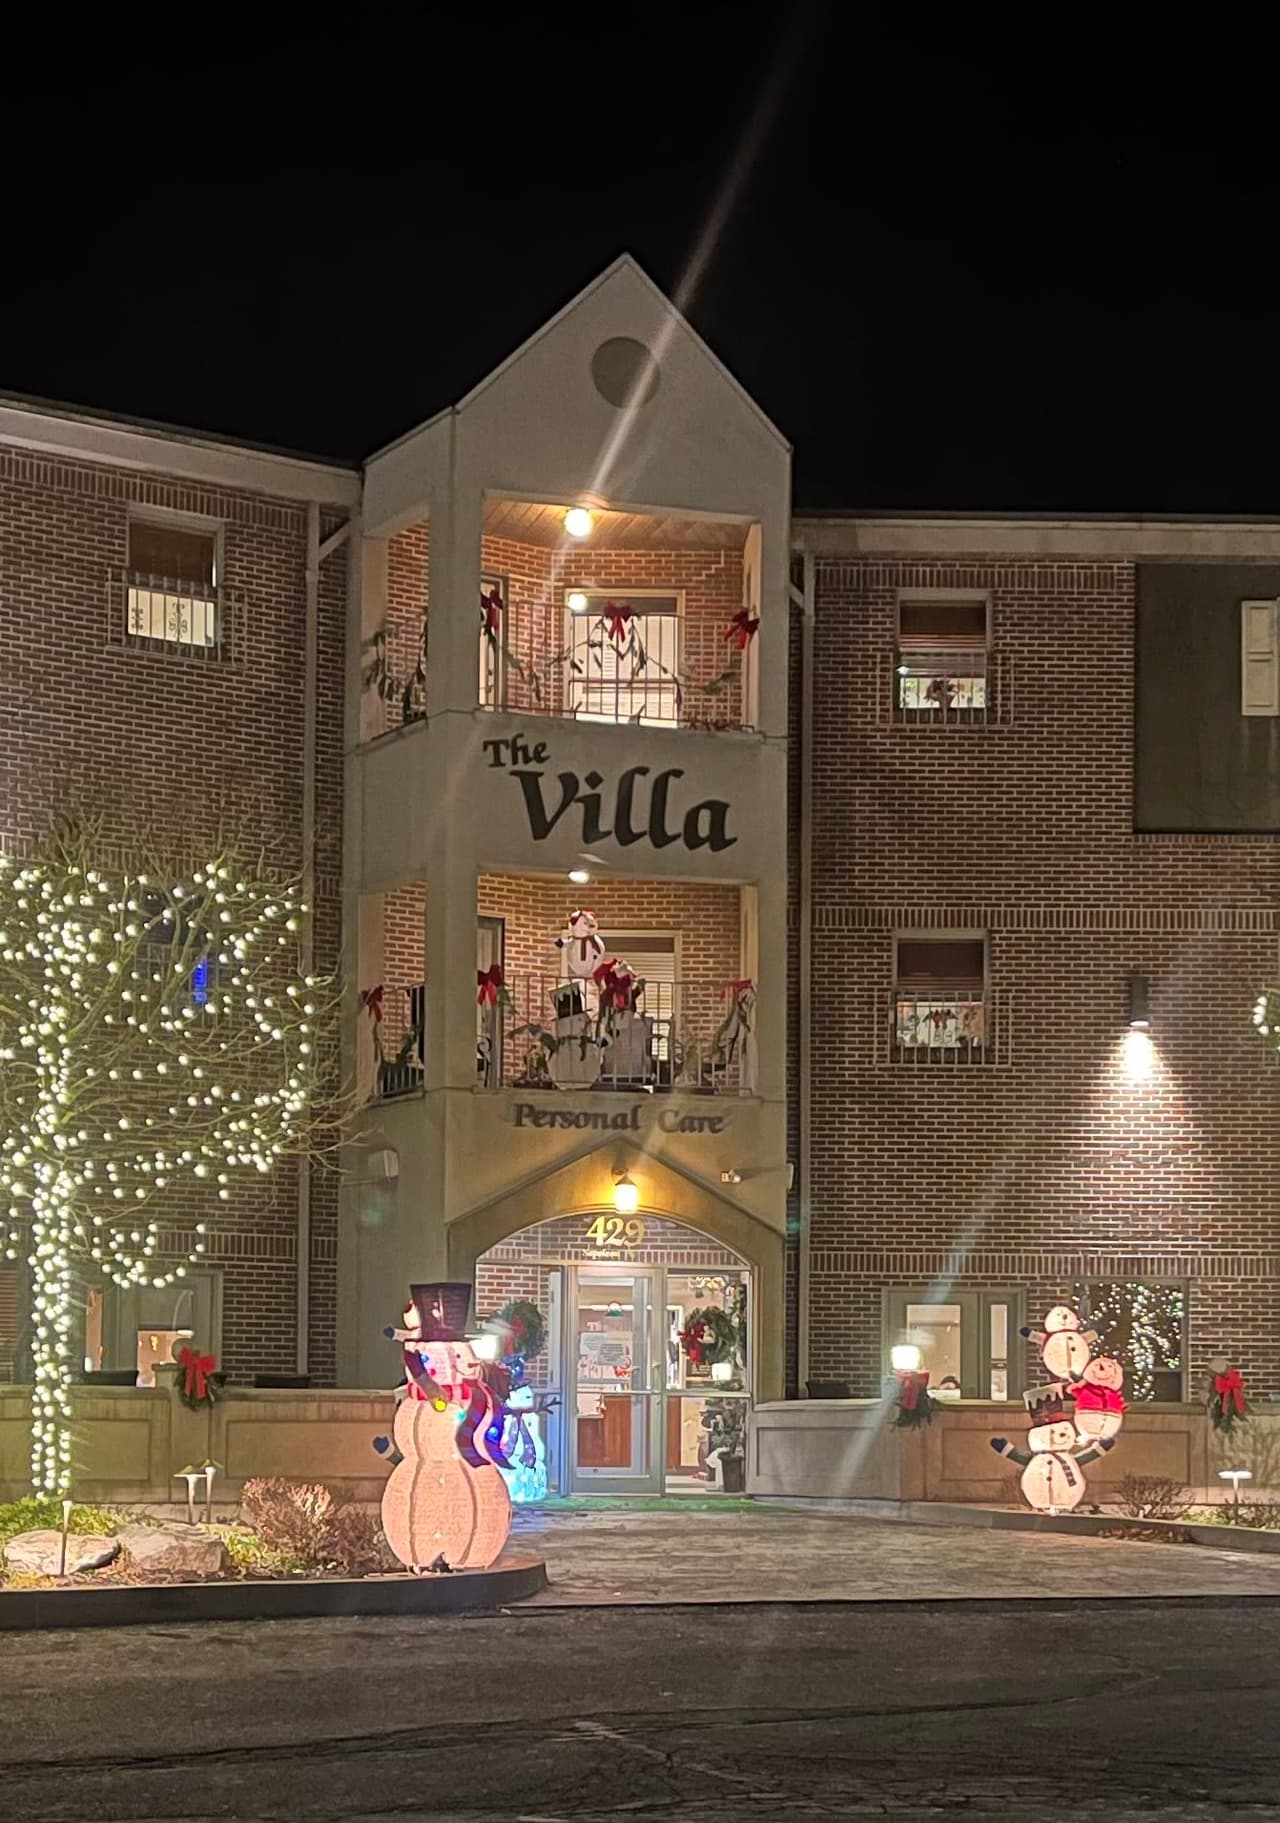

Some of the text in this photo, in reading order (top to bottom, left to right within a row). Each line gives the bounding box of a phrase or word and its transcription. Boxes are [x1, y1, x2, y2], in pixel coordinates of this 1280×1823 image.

[483, 733, 550, 767] The
[509, 766, 738, 852] Villa
[513, 1103, 724, 1133] Personal Care
[585, 1216, 645, 1246] 429
